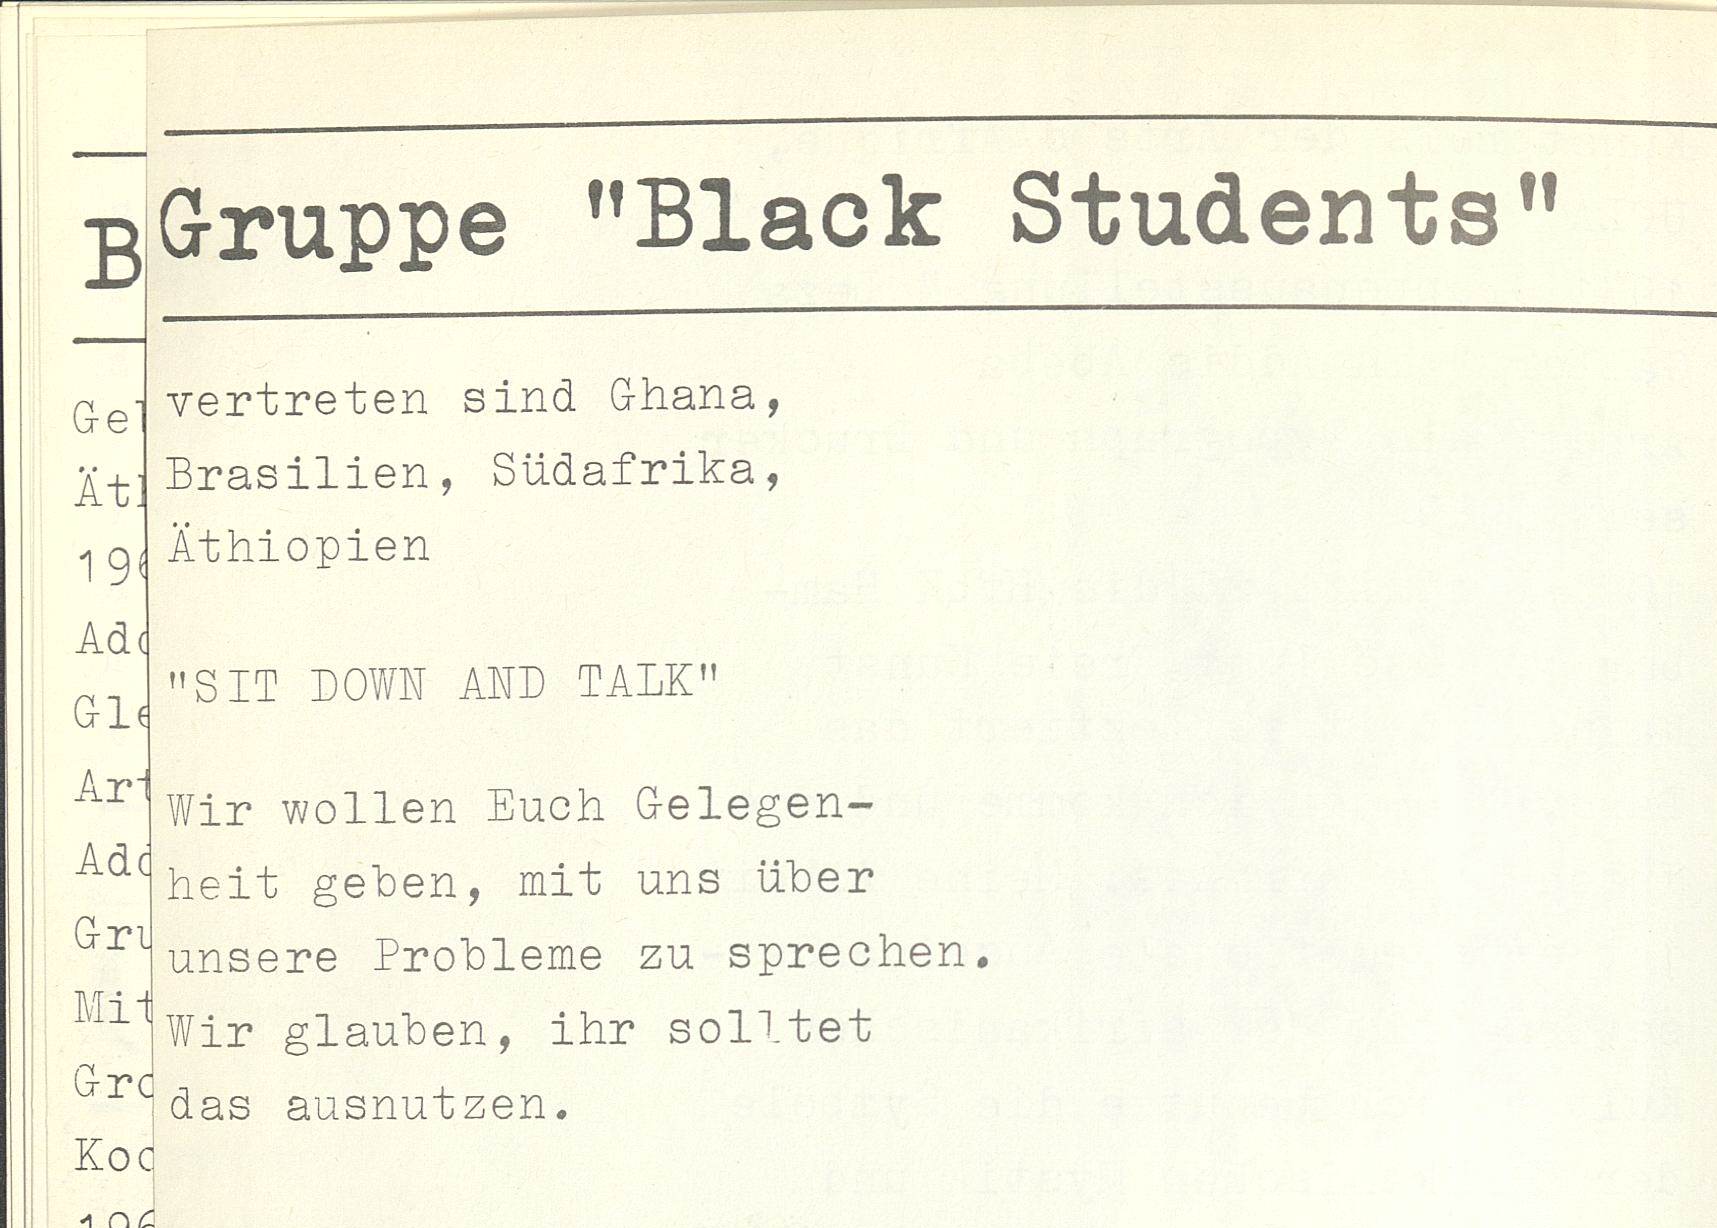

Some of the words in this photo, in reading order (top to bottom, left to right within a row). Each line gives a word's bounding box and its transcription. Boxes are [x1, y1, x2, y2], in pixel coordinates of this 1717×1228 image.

[160, 188, 506, 273] Gruppe
[589, 174, 941, 251] "Black
[1013, 171, 1556, 246] Students"
[167, 382, 427, 417] vertreten
[464, 379, 576, 413] sind
[611, 377, 779, 418] Ghana,
[166, 456, 451, 496] Brasilien,
[493, 450, 778, 491] Südafrika,
[168, 522, 429, 569] Äthiopien
[170, 669, 277, 703] "SIT
[311, 668, 425, 702] DOWN
[460, 666, 544, 699] AND
[579, 663, 716, 697] TALK"
[167, 793, 251, 826] Wir
[282, 791, 456, 824] wollen
[488, 788, 604, 822] Euch
[637, 786, 873, 828] Gelegen-
[168, 866, 277, 900] heit
[314, 864, 479, 908] geben,
[519, 862, 601, 896] mit
[638, 869, 719, 895] uns
[757, 860, 874, 893] über
[169, 948, 337, 973] unsere
[374, 937, 601, 972] Probleme
[640, 945, 693, 969] zu
[730, 933, 988, 976] sprechen.
[166, 1014, 253, 1047] Wir
[285, 1012, 510, 1056] glauben,
[552, 1011, 634, 1045] ihr
[171, 1087, 250, 1121] das
[287, 1086, 567, 1121] ausnutzen.
